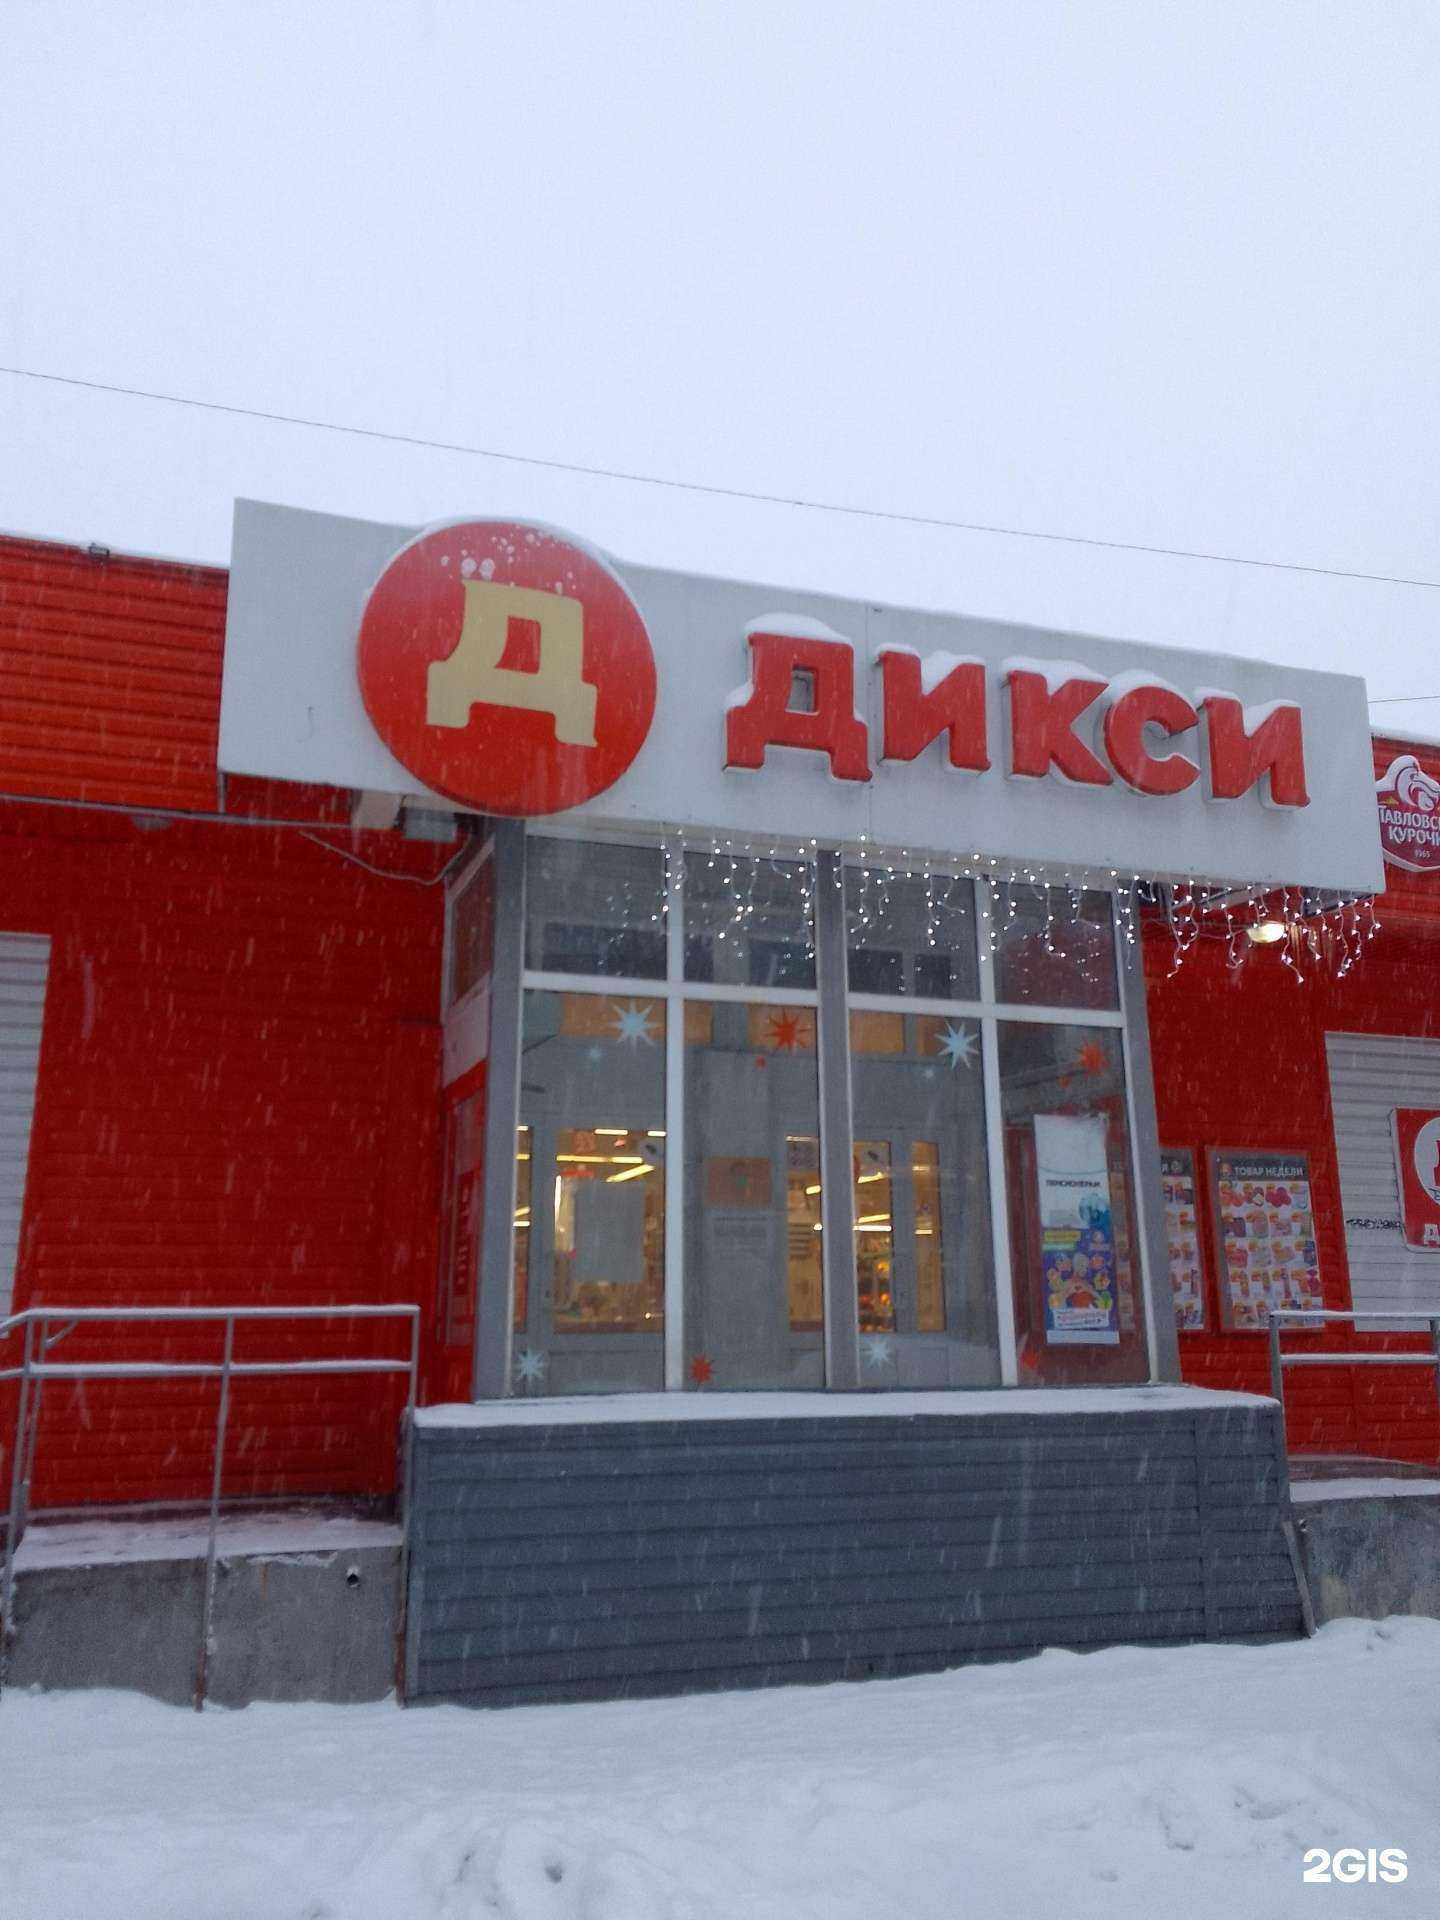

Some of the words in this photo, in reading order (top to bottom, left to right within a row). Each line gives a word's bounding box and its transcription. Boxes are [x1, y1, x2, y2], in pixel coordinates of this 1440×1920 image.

[426, 579, 598, 748] Д
[722, 632, 1311, 809] ДИКСИ
[1379, 805, 1440, 830] АВЛОВС
[1234, 1166, 1264, 1177] ТОВАР
[1265, 1166, 1304, 1178] НЕДЕЛИ
